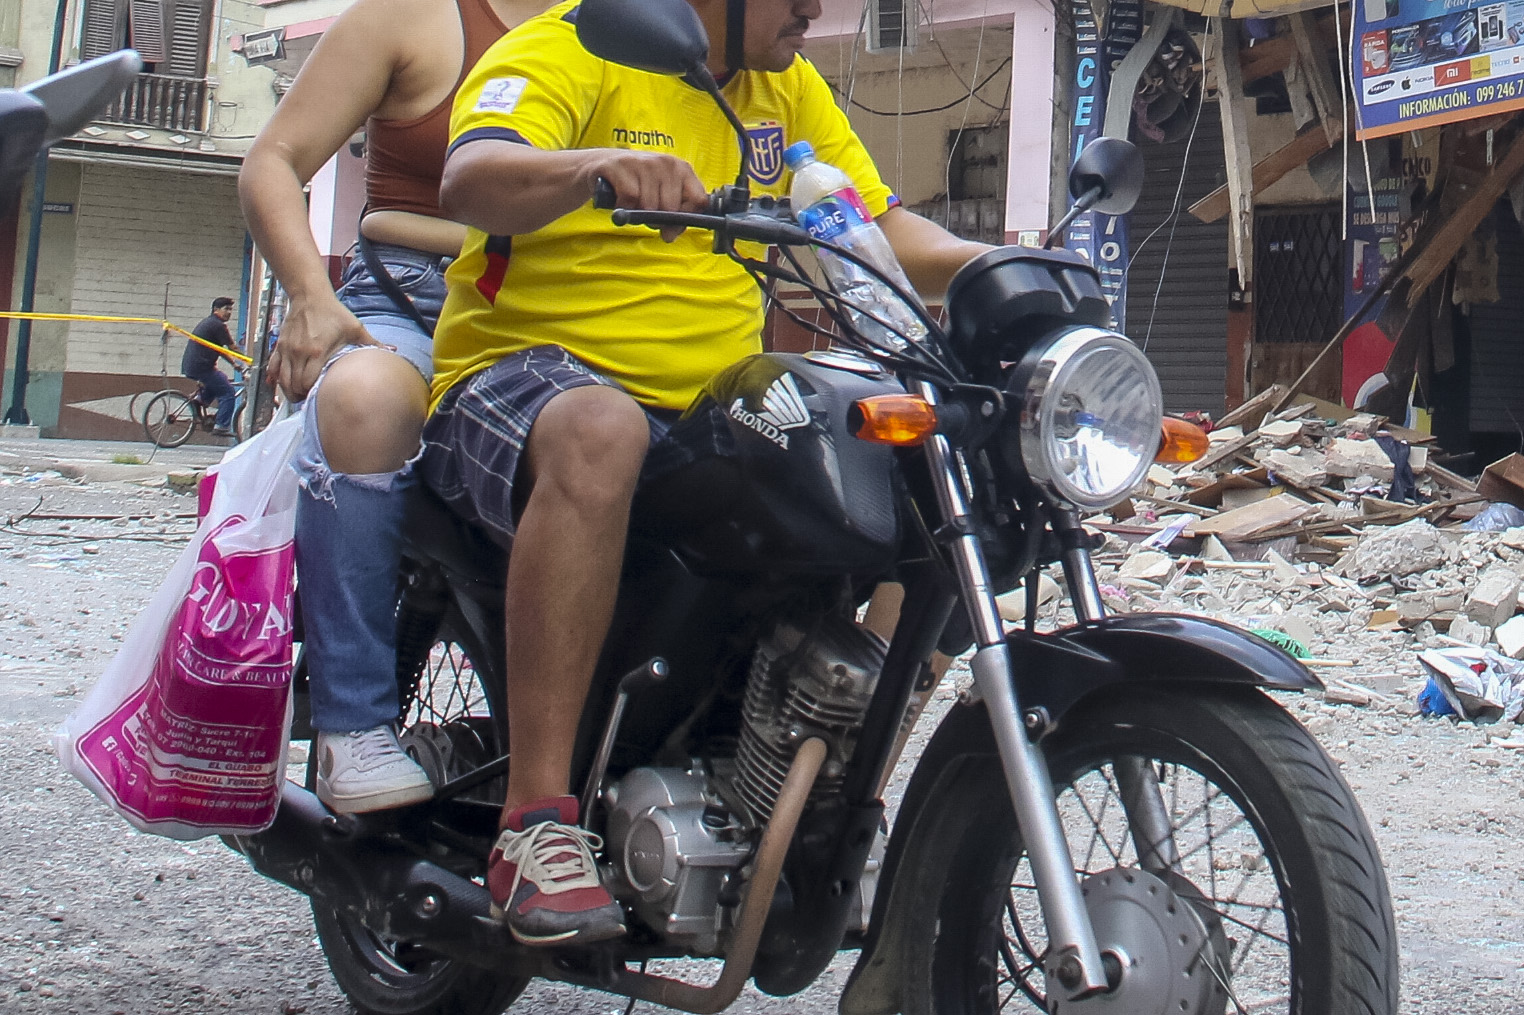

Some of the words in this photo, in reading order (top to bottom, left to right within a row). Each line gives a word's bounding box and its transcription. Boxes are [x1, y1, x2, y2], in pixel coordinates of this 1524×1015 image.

[1414, 75, 1434, 84] NOKIA
[1399, 89, 1471, 119] INFORMACIÓN:
[1476, 85, 1494, 103] 099
[1497, 82, 1515, 100] 246
[808, 210, 845, 238] PURE
[731, 406, 790, 451] HONDA
[169, 769, 224, 785] TERMINAL
